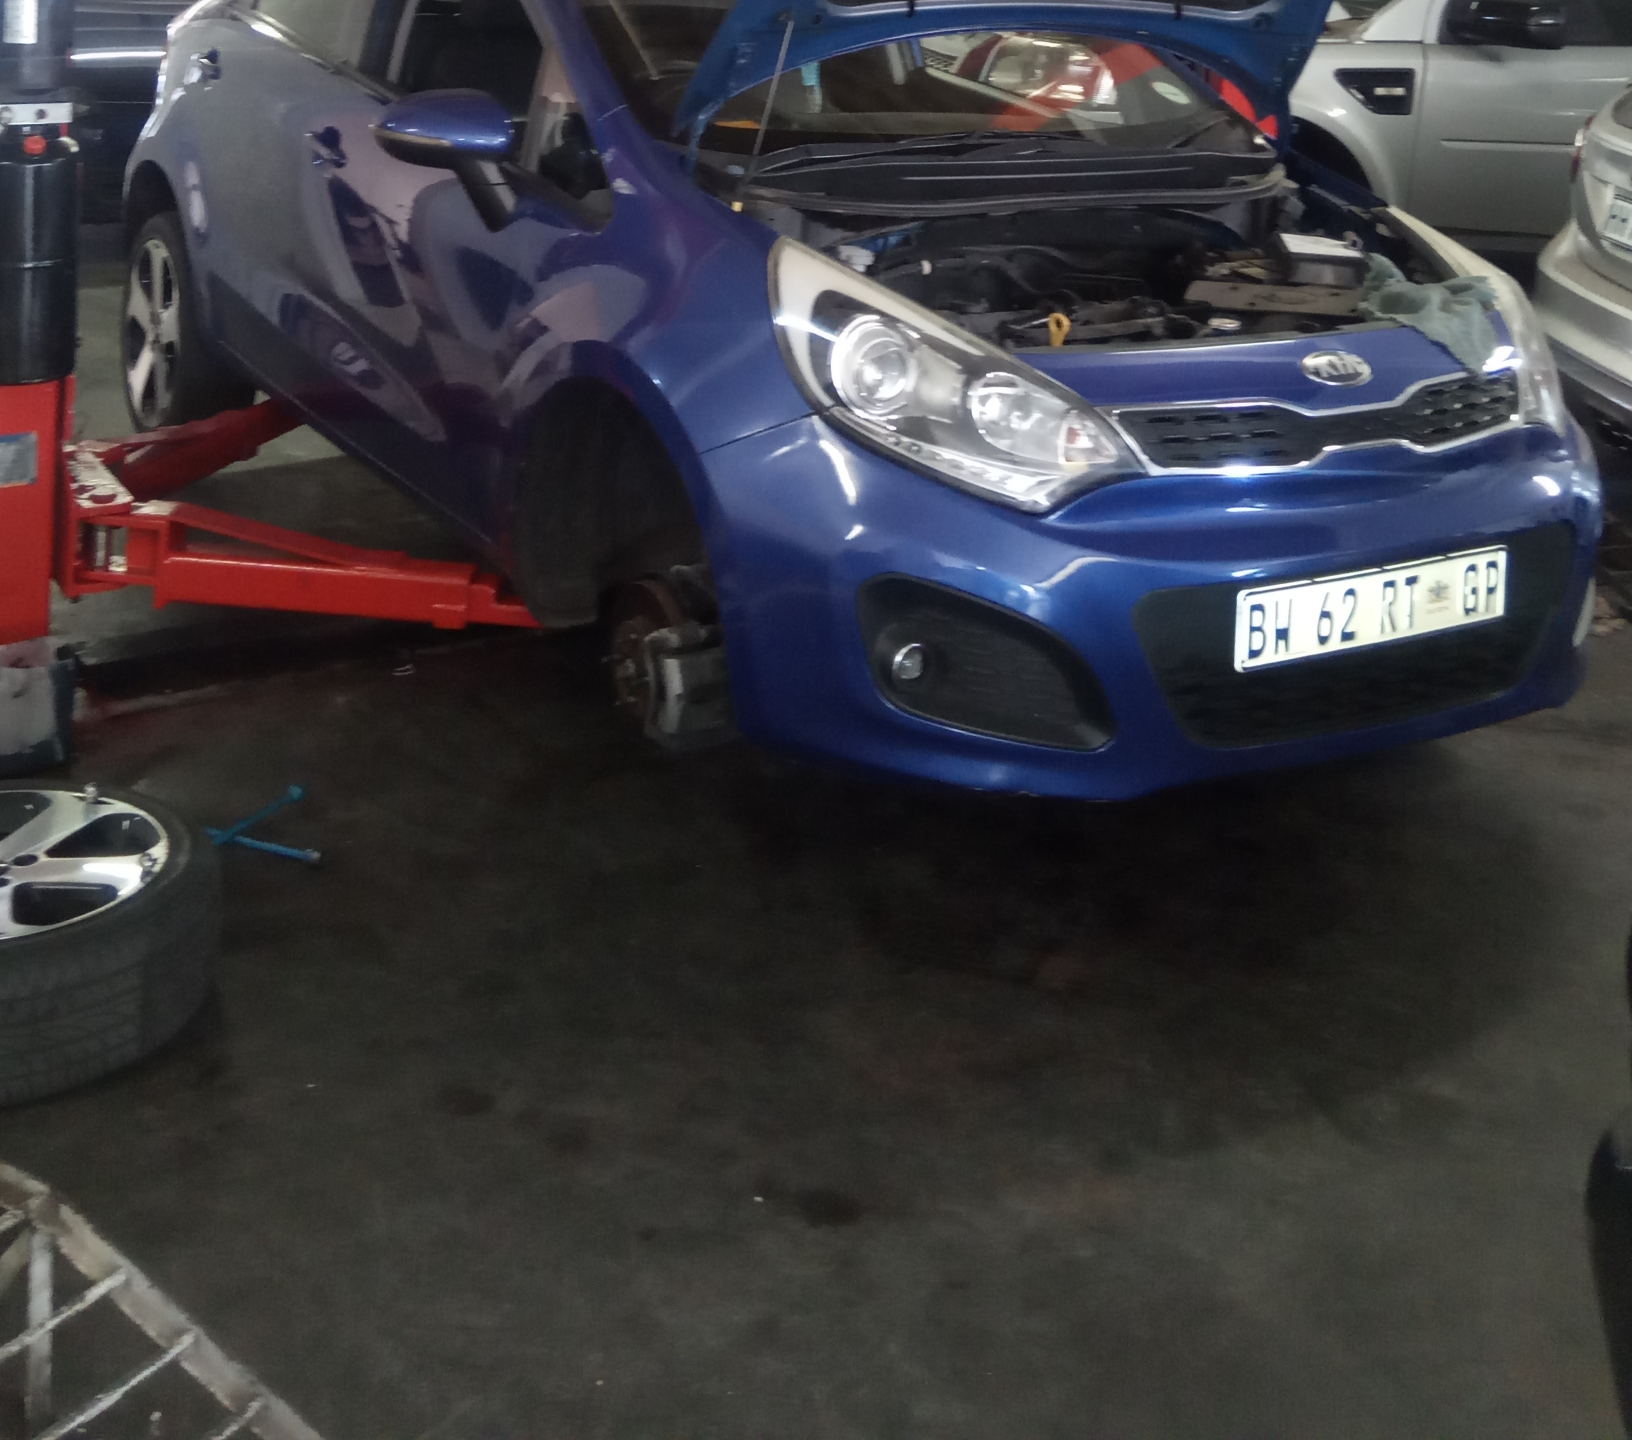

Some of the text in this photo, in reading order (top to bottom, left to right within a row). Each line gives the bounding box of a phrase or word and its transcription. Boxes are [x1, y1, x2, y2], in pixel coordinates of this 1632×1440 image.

[1313, 354, 1368, 380] KIA
[1248, 559, 1499, 660] BH 62 RT GP
